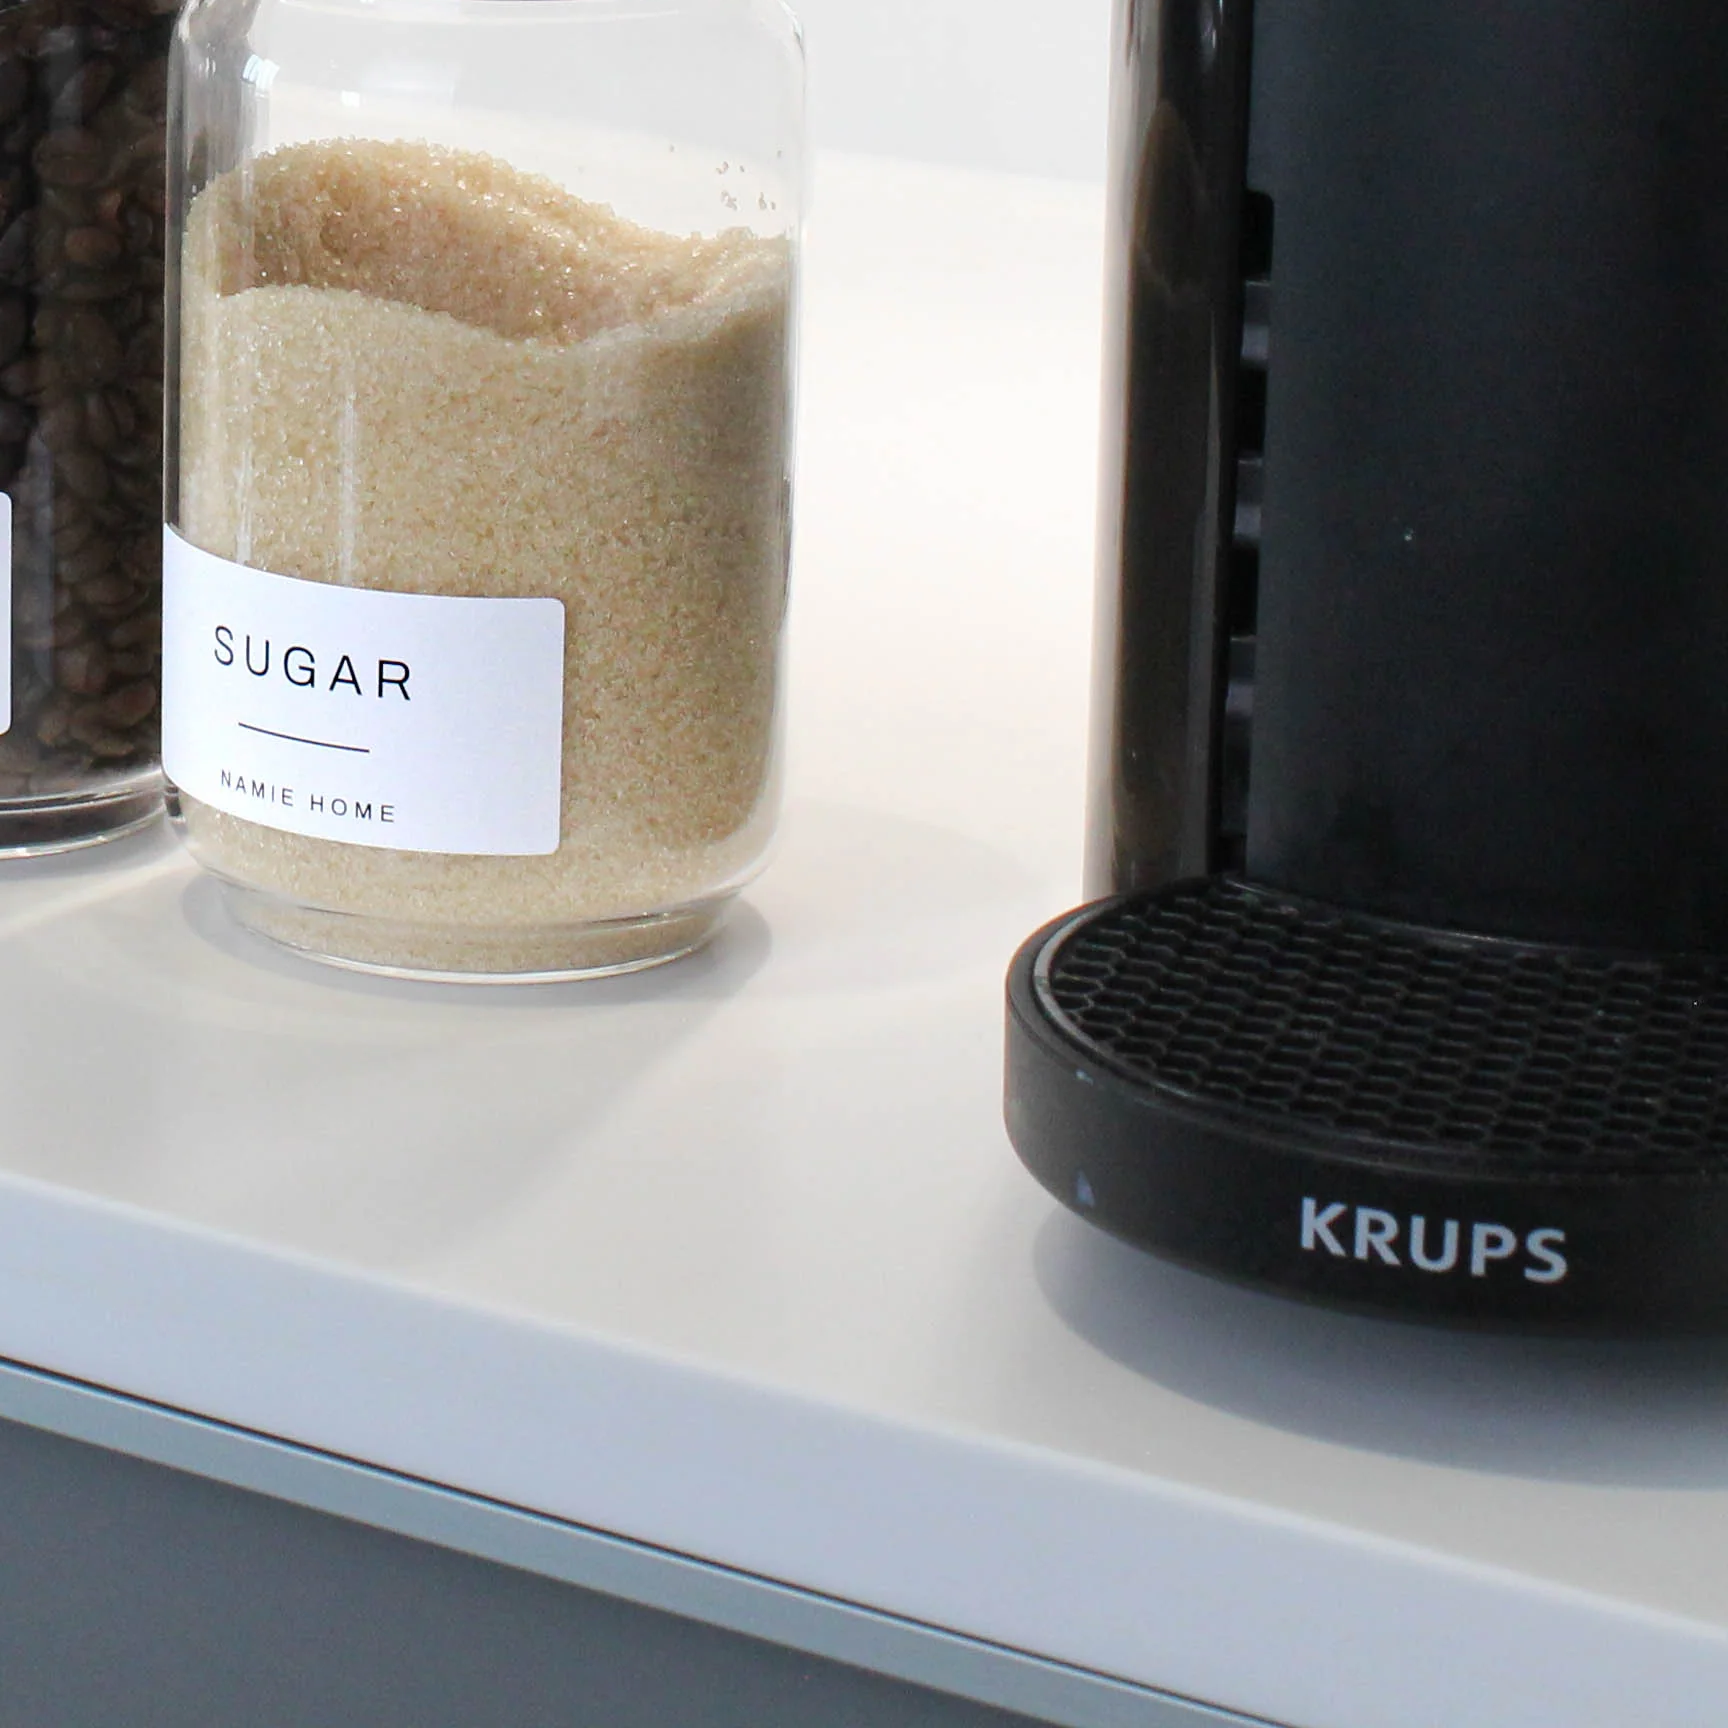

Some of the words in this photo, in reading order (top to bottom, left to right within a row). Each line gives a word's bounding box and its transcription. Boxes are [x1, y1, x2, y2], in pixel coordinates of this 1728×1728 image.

[212, 623, 412, 702] SUGAR
[220, 768, 295, 807] NAMIE
[309, 793, 396, 824] HOME
[1299, 1195, 1569, 1283] KRUPS
